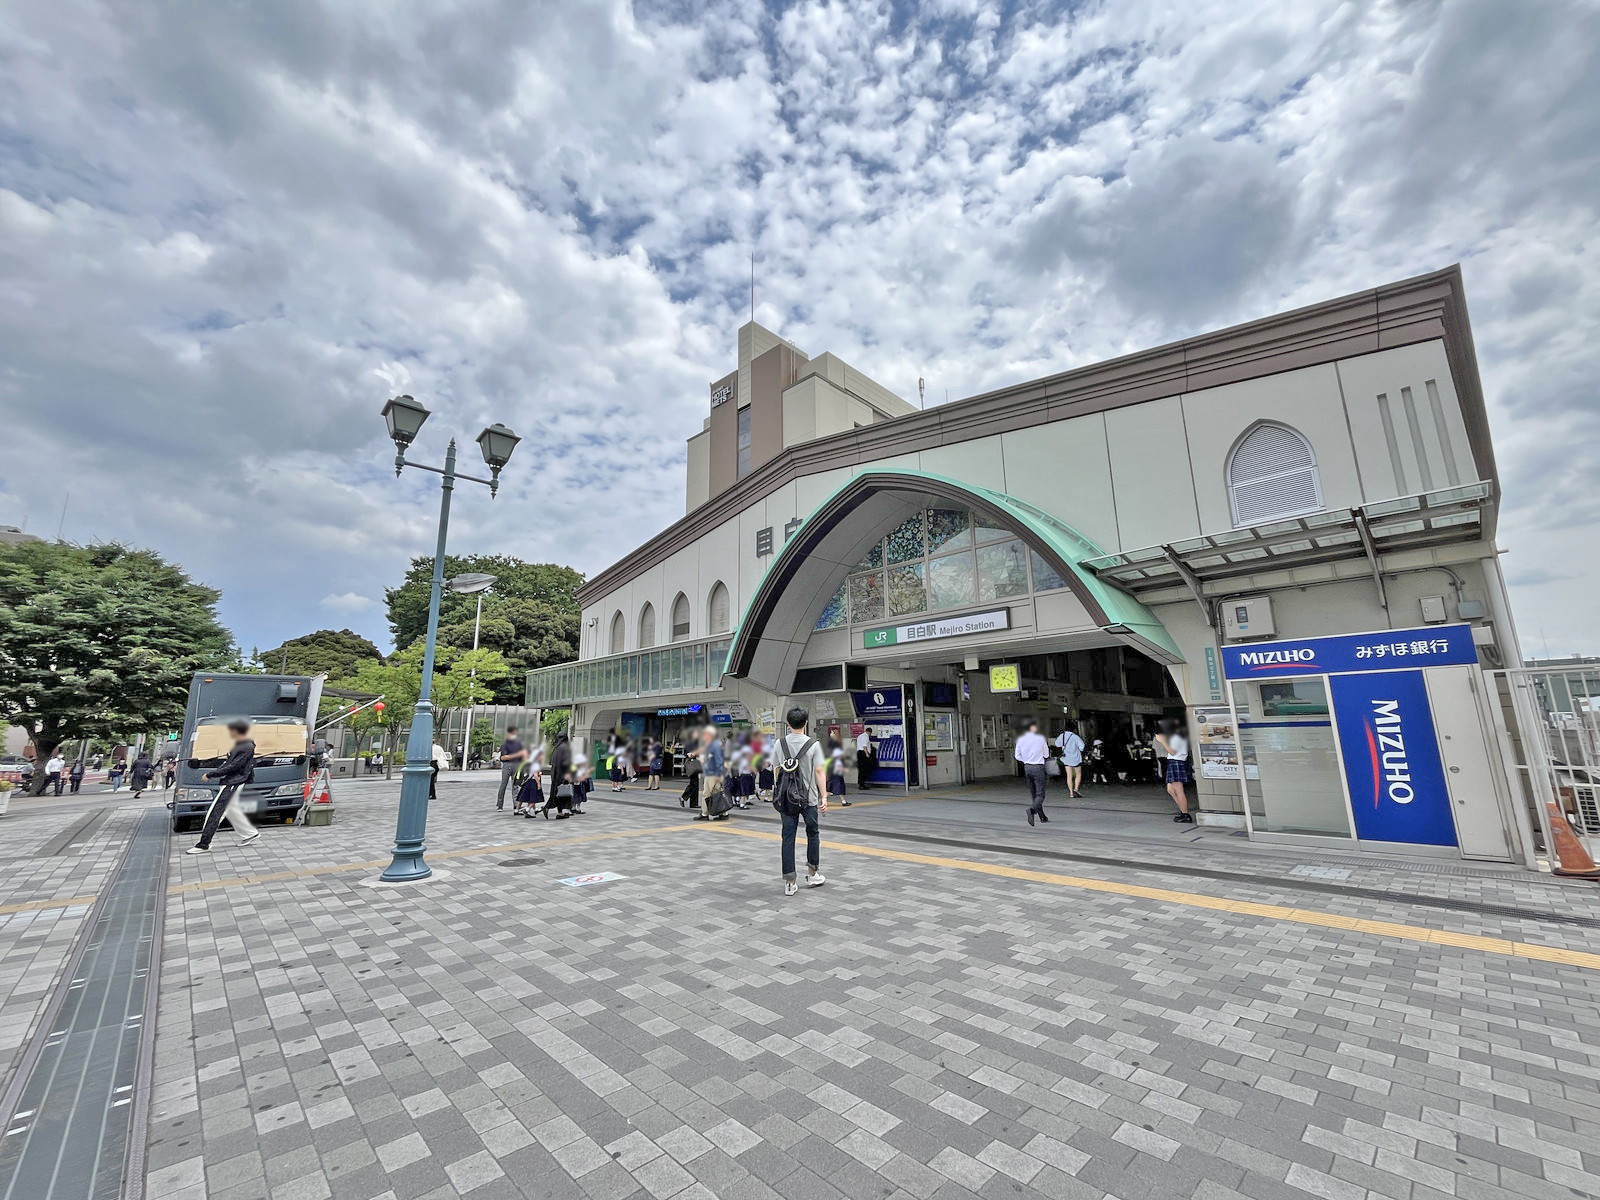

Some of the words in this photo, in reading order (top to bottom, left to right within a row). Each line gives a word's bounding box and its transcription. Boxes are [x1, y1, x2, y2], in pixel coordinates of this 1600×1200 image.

[874, 631, 887, 641] JR
[907, 623, 937, 639] 目白駅
[939, 624, 964, 636] Mejiro
[965, 620, 995, 632] Station
[1240, 648, 1315, 666] MIZUHO
[1355, 639, 1449, 659] みずほ銀行
[1371, 700, 1415, 804] MIZUHO
